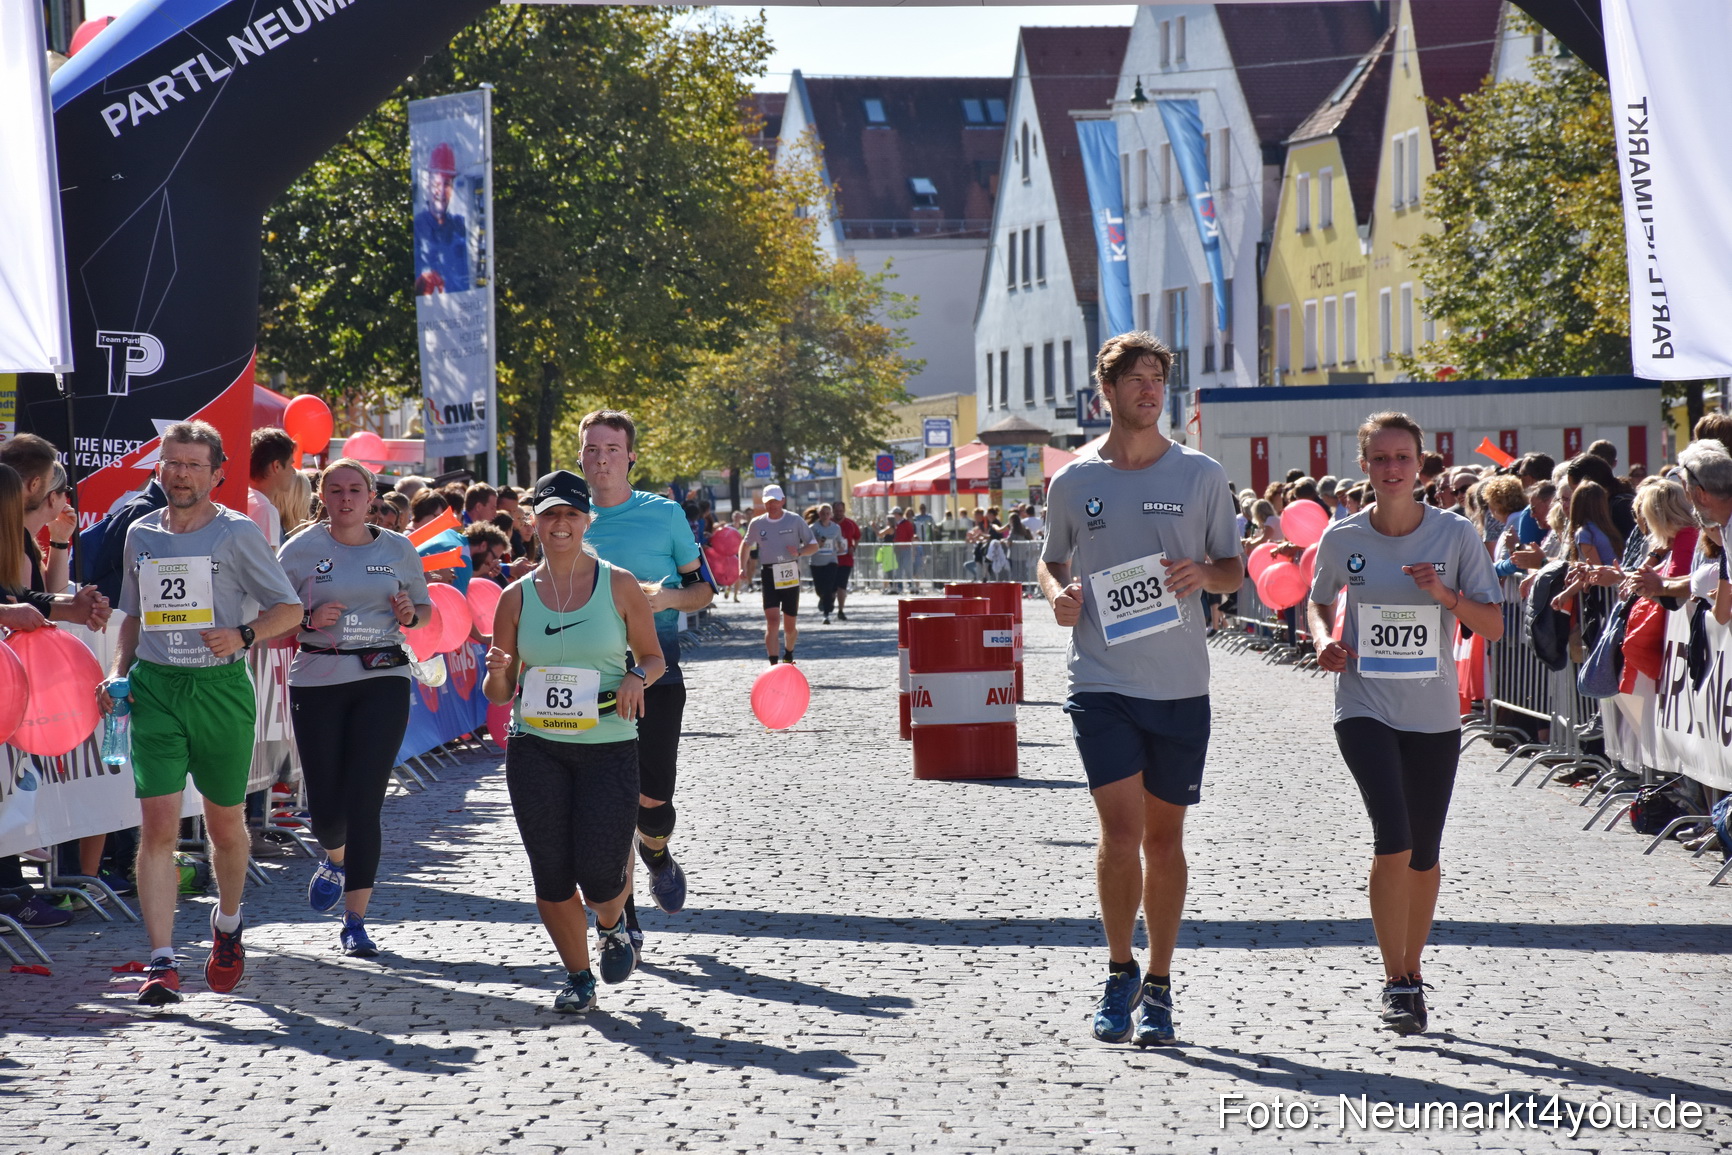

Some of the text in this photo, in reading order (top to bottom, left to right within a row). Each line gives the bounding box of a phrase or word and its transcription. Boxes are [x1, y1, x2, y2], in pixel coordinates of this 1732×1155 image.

[100, 0, 352, 138] PARTL NEUM
[1310, 262, 1334, 290] HOTEL
[100, 335, 140, 344] Team Partl
[73, 437, 143, 454] THE NEXT
[74, 452, 122, 468] YEARS
[1143, 501, 1184, 513] BOCK
[158, 564, 189, 574] BOCK
[780, 569, 794, 579] 128
[1112, 565, 1146, 582] BOCK
[160, 578, 187, 600] 23
[1107, 577, 1162, 612] 3033
[1116, 604, 1156, 619] PARTL Neumarkt
[1381, 611, 1416, 619] BOCK
[162, 613, 187, 623] Franz
[344, 613, 362, 626] 19.
[343, 626, 381, 634] Neumarkter
[1370, 624, 1428, 647] 3079
[166, 631, 188, 646] 19.
[341, 634, 374, 642] Stadtlauf
[167, 646, 212, 655] Neumarkte
[168, 654, 206, 664] Stadtlauf
[545, 673, 578, 683] BOCK
[546, 687, 573, 709] 63
[542, 719, 578, 729] Sabrina
